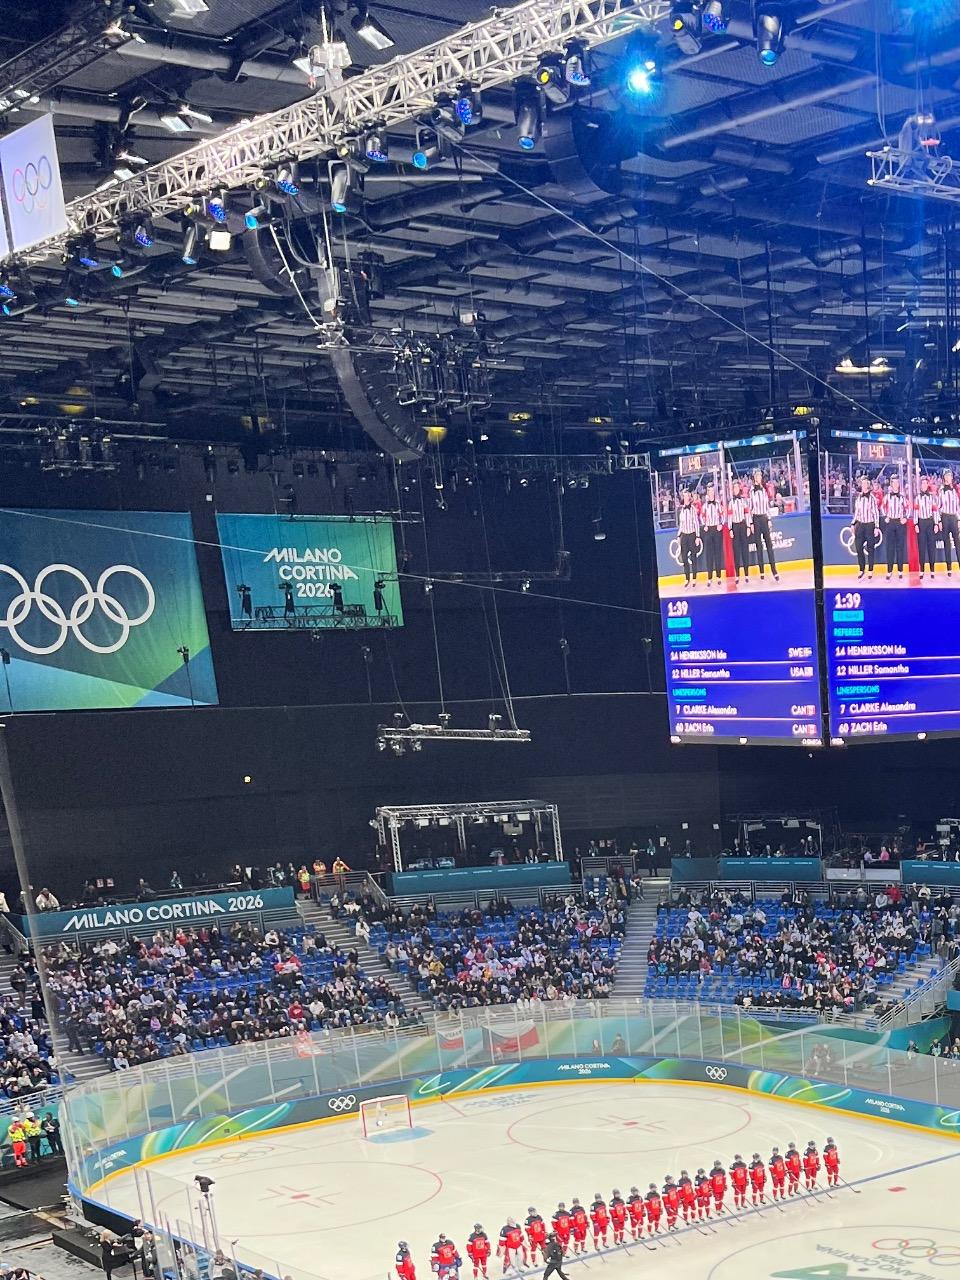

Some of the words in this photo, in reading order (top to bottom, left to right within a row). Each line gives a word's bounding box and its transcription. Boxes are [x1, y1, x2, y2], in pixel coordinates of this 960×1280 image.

[263, 547, 342, 563] MILANO
[279, 564, 358, 580] CORTINA
[296, 582, 334, 598] 2026
[834, 593, 861, 609] 1:39
[667, 601, 689, 617] 1:39
[833, 627, 864, 637] REFEREES
[847, 645, 893, 656] HENRIKSSON
[680, 669, 700, 679] HILLER
[790, 667, 805, 677] USA
[836, 666, 847, 676] 12
[848, 664, 873, 675] HILLER
[874, 664, 910, 674] Samantha
[683, 705, 707, 715] CLARKE
[791, 705, 807, 715] CAN
[849, 703, 880, 713] CLARKE
[880, 701, 916, 712] Alexandra
[684, 723, 702, 733] ZACH
[791, 724, 807, 734] CAN
[838, 723, 849, 734] 60
[850, 722, 873, 733] ZACH
[873, 721, 887, 732] Erin
[62, 909, 143, 932] MILANO
[146, 900, 226, 922] CORTINA
[228, 895, 264, 912] 2026
